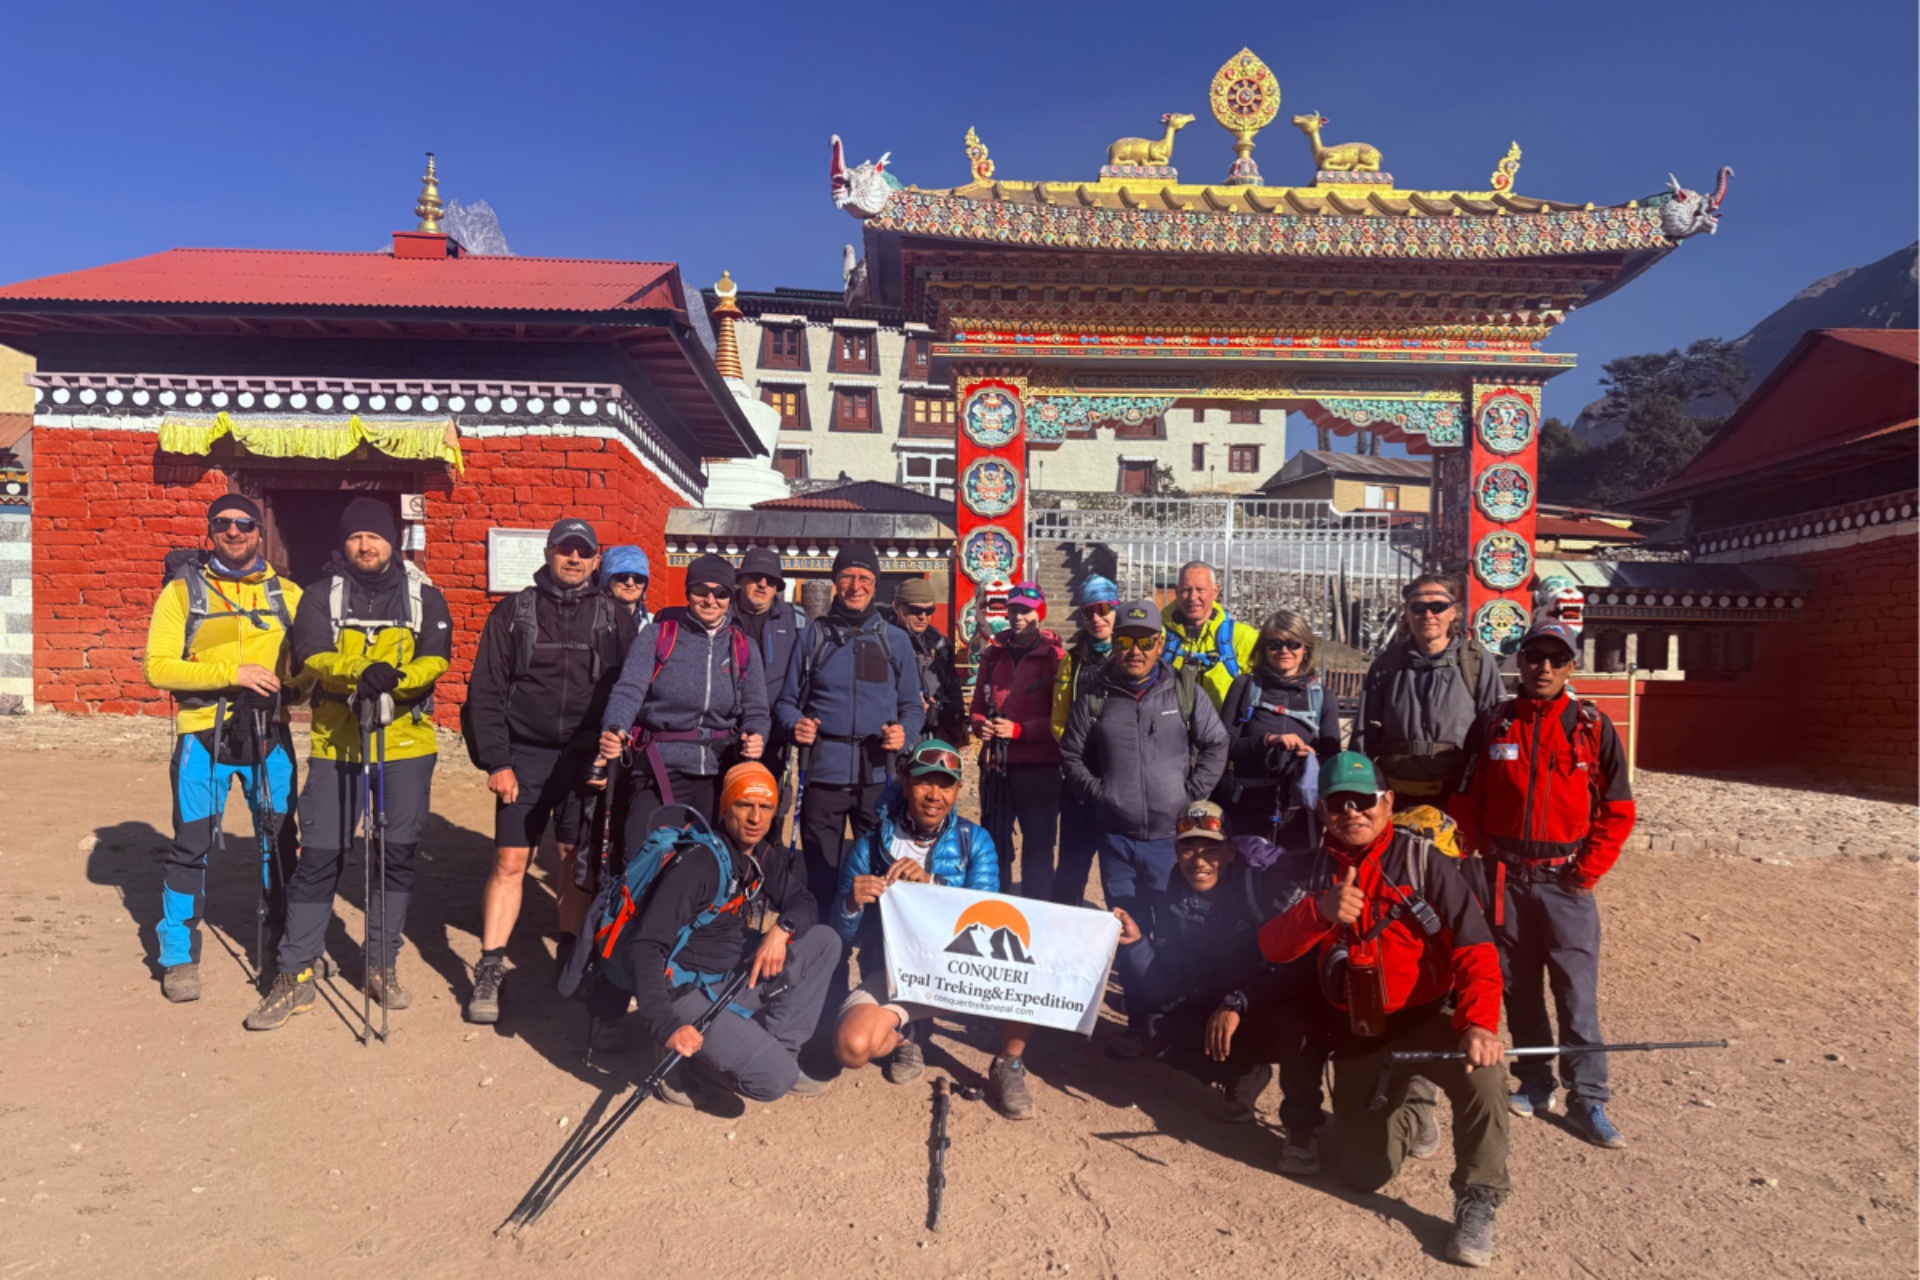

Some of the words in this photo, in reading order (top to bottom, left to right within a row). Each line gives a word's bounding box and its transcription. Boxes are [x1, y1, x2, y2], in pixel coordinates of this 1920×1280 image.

[948, 960, 1028, 984] CONQUERI
[897, 967, 931, 988] epal
[935, 976, 1084, 1013] Treking&Expedition
